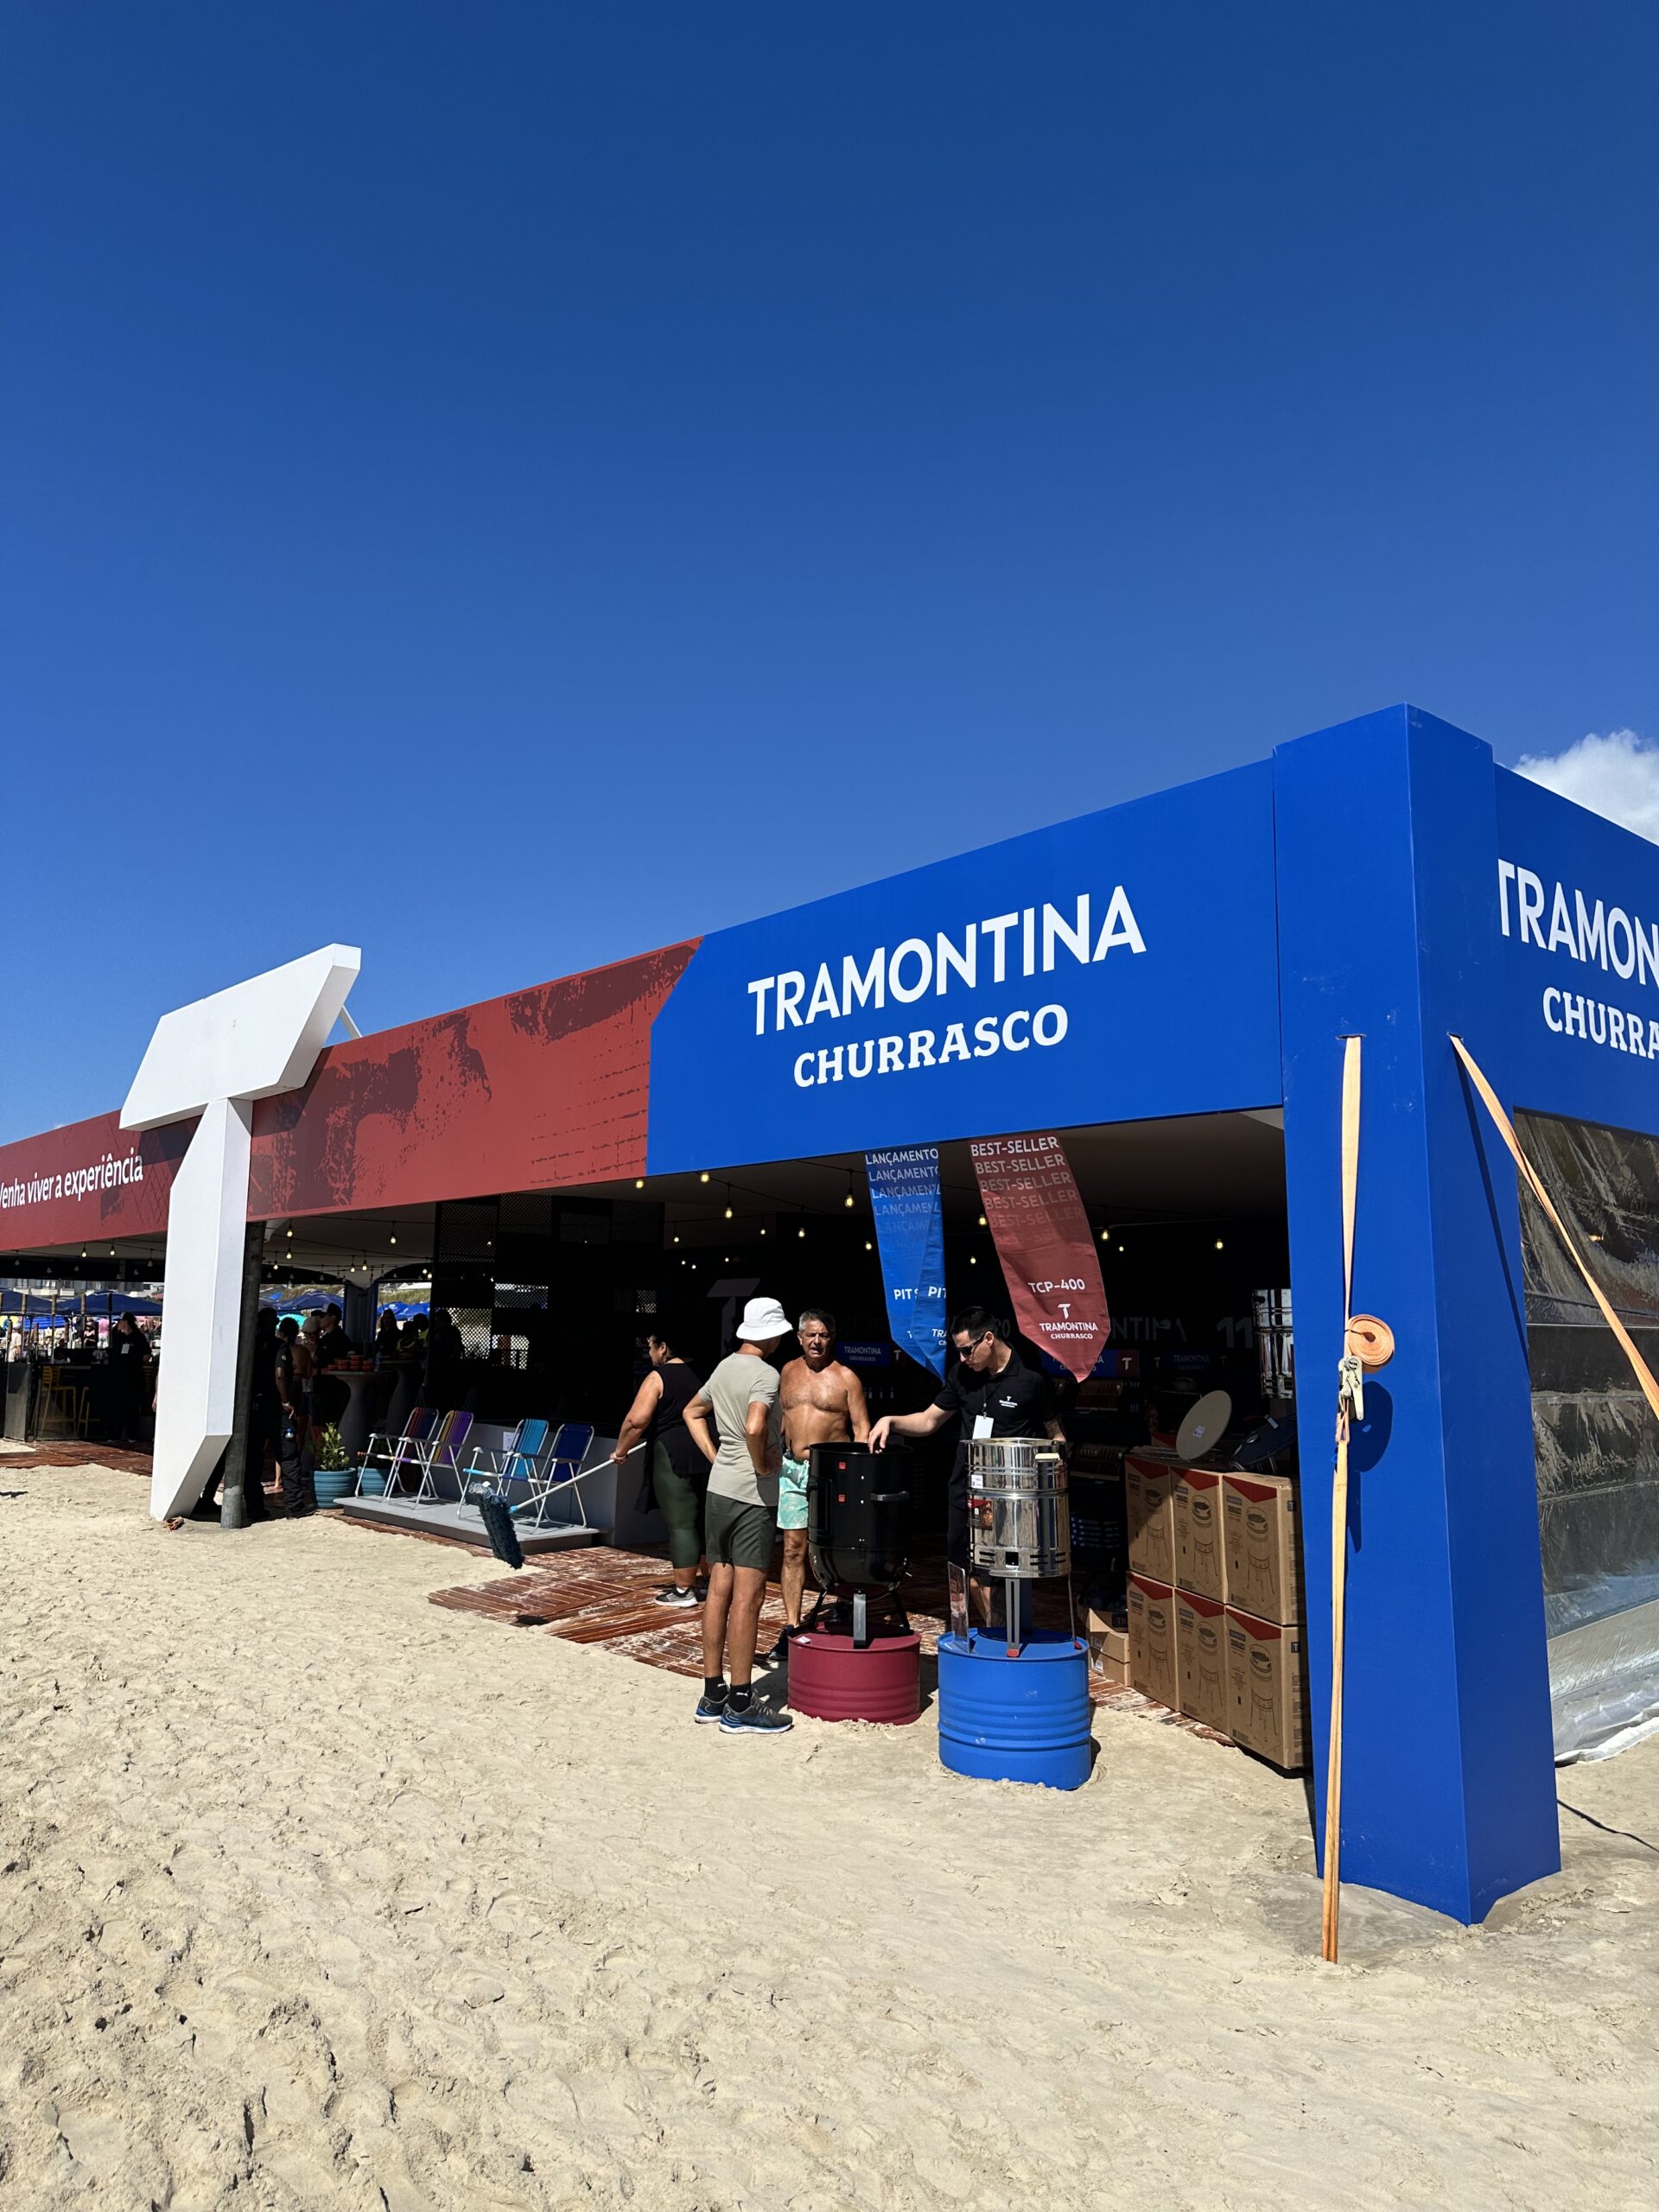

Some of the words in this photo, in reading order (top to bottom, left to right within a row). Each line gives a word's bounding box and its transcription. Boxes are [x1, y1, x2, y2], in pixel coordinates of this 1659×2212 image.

[747, 885, 1147, 1035] TRAMONTINA
[793, 1004, 1069, 1088] CHURRASCO
[970, 1136, 1059, 1156] BEST-SELLER
[865, 1148, 938, 1166] LANÇAMENTO
[975, 1154, 1065, 1174] BEST-SELLER
[27, 1171, 54, 1204] viver
[54, 1179, 62, 1198] a
[64, 1147, 143, 1201] experiência
[980, 1172, 1071, 1192] BEST-SELLER
[984, 1189, 1078, 1210] BEST-SELLER
[893, 1288, 912, 1300] PIT
[1028, 1279, 1085, 1294] TCP-400
[1039, 1322, 1098, 1332] TRAMONTINA
[844, 1345, 882, 1355] TRAMONTINA
